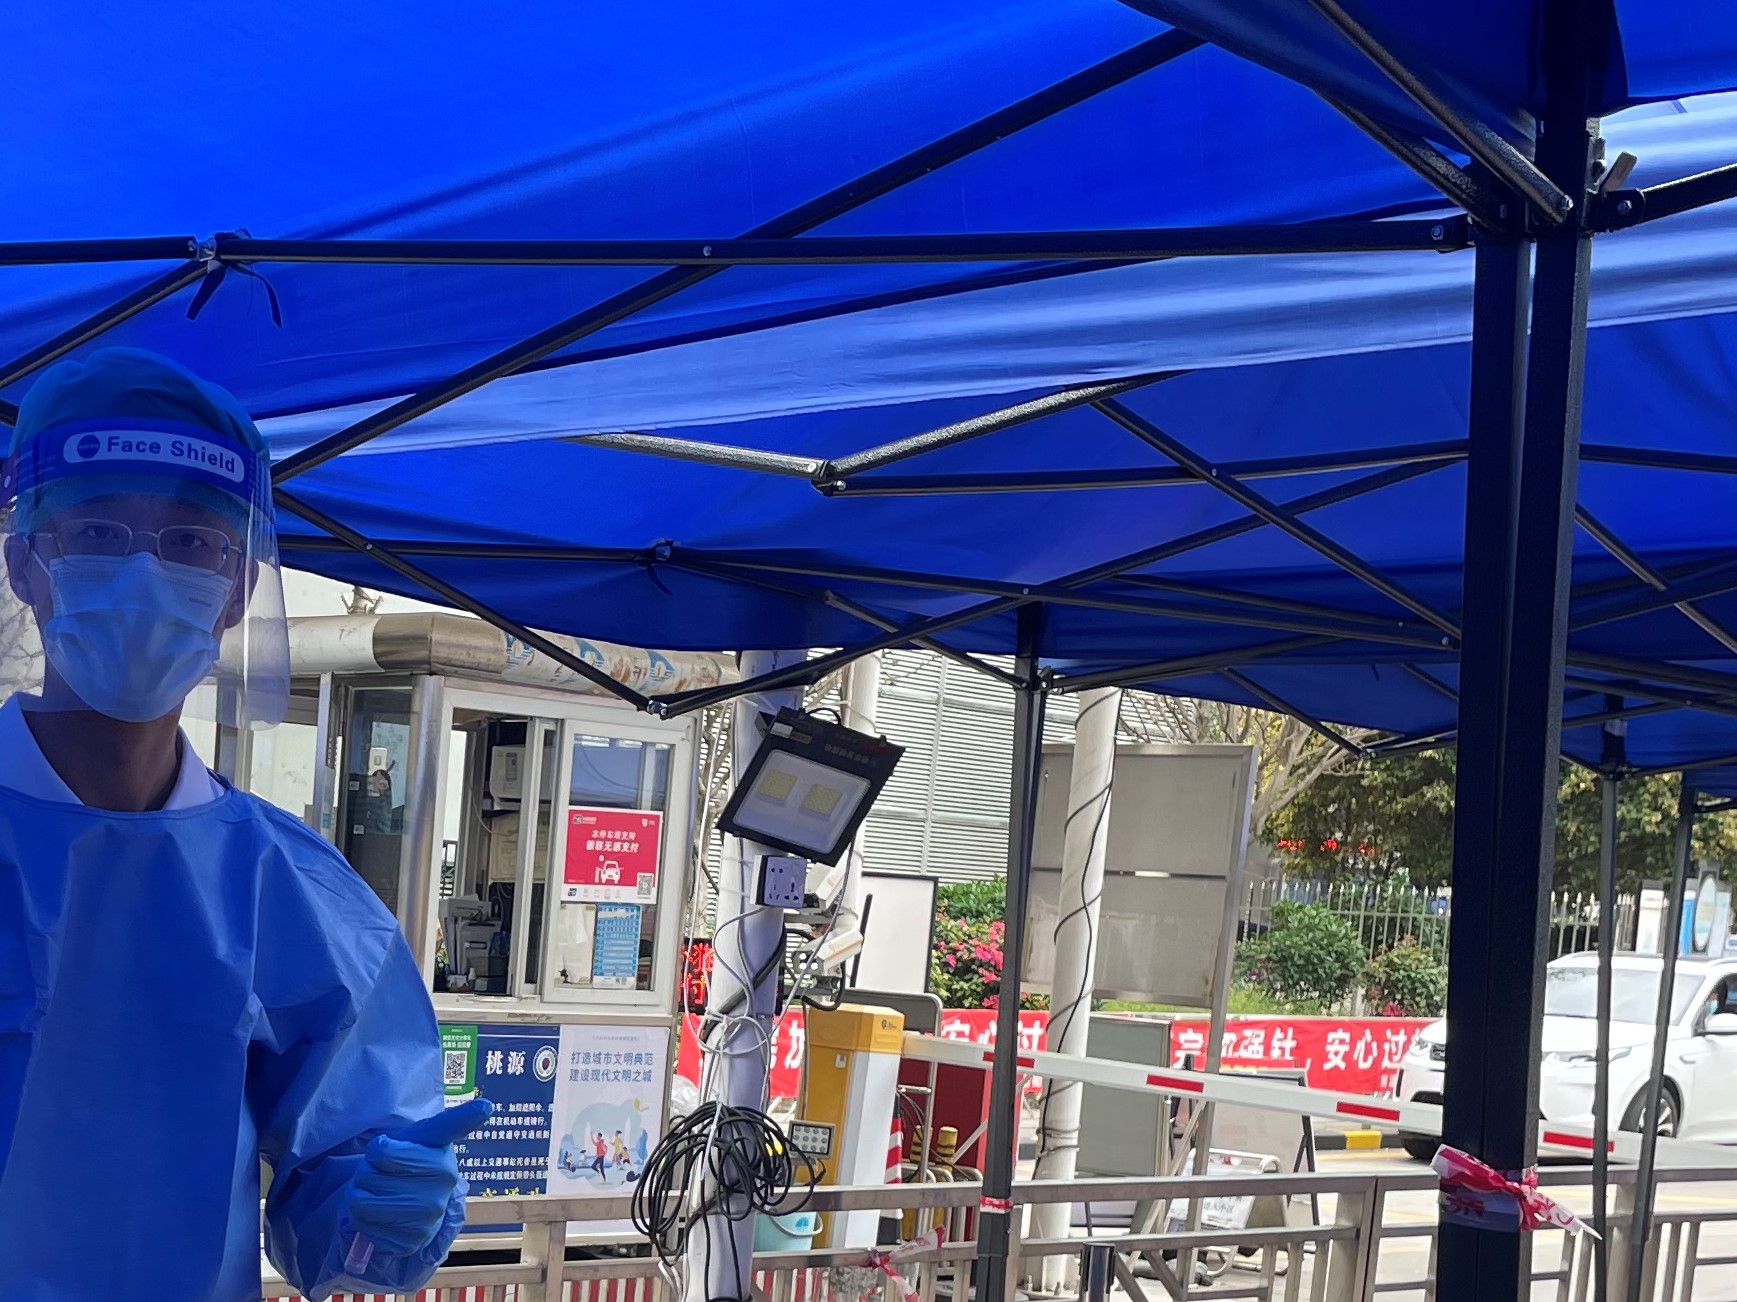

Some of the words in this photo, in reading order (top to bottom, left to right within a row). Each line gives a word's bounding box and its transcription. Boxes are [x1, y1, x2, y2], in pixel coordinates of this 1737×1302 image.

[107, 436, 162, 455] Face
[170, 440, 235, 474] Shield
[485, 1050, 526, 1076] 桃源
[570, 1051, 655, 1066] 打造城市文明典范
[568, 1068, 653, 1083] 建设现代文明之城
